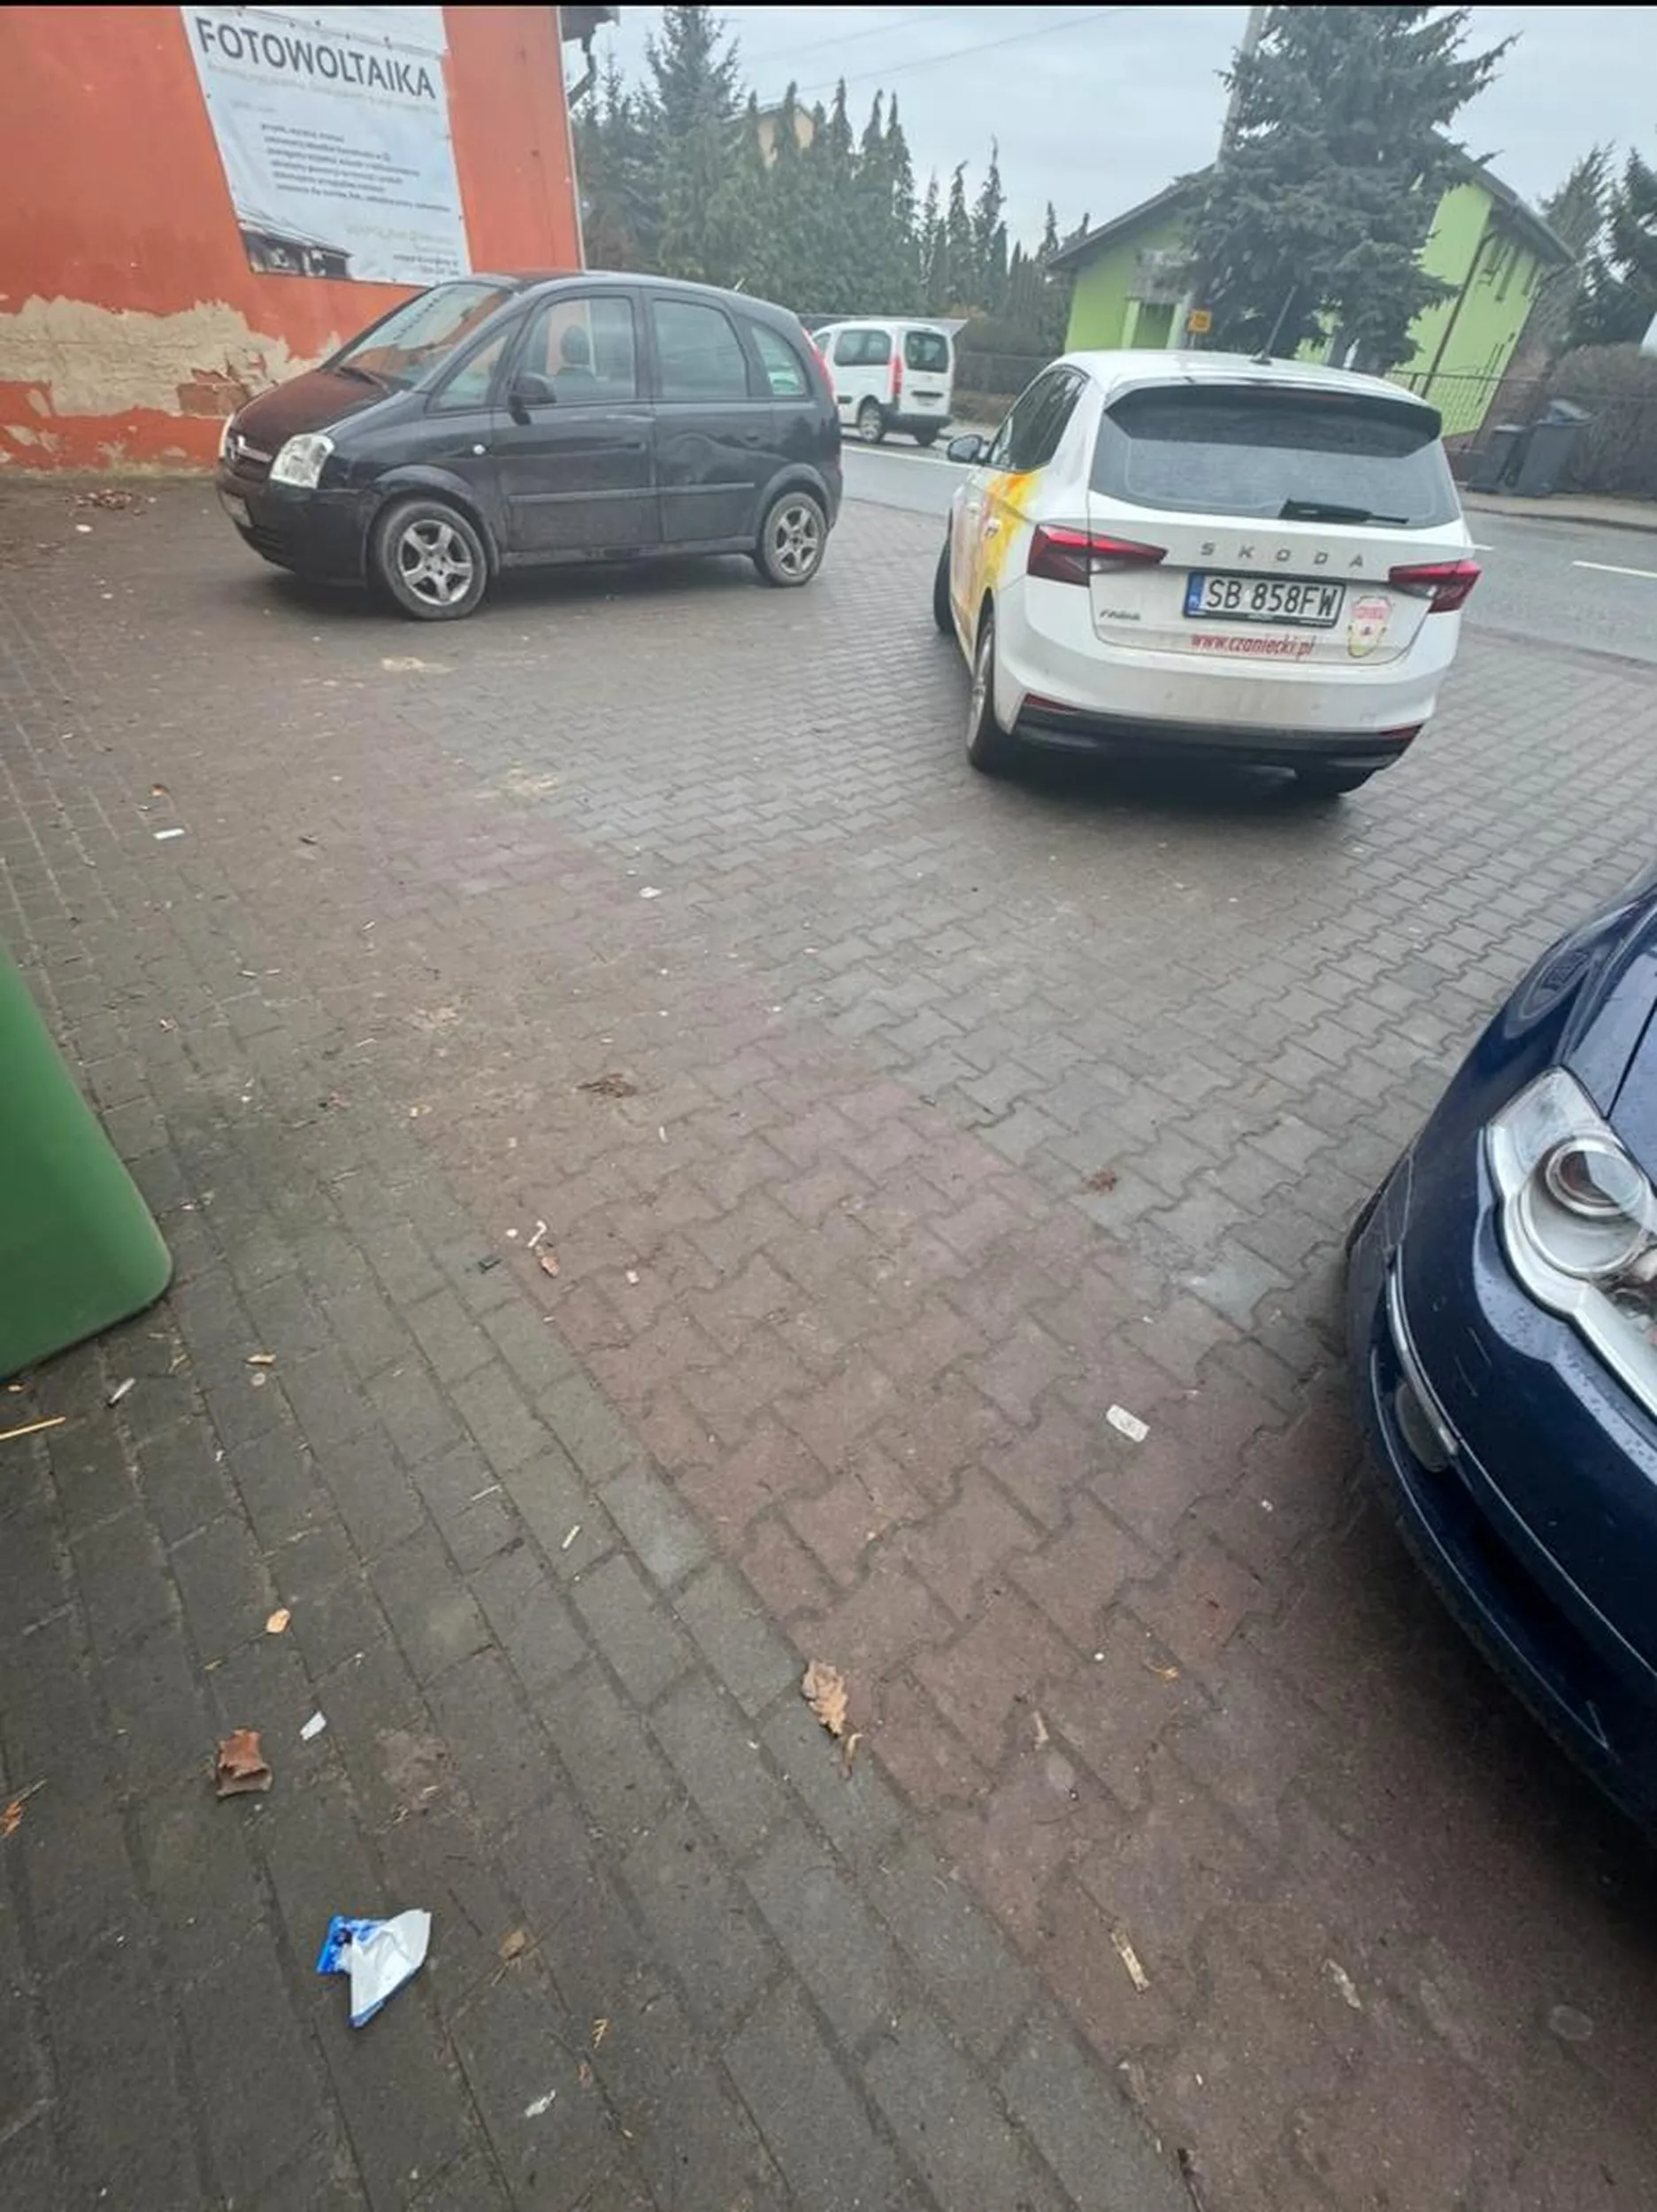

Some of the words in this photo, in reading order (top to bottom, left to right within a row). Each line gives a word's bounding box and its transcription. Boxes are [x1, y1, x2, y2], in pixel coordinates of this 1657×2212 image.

[195, 16, 436, 100] FOTOWOLTAIKA
[1200, 541, 1365, 568] SKODA
[1206, 579, 1242, 610] SB
[1251, 582, 1339, 617] 858FW
[1191, 634, 1316, 662] www.czaniecki.pl
